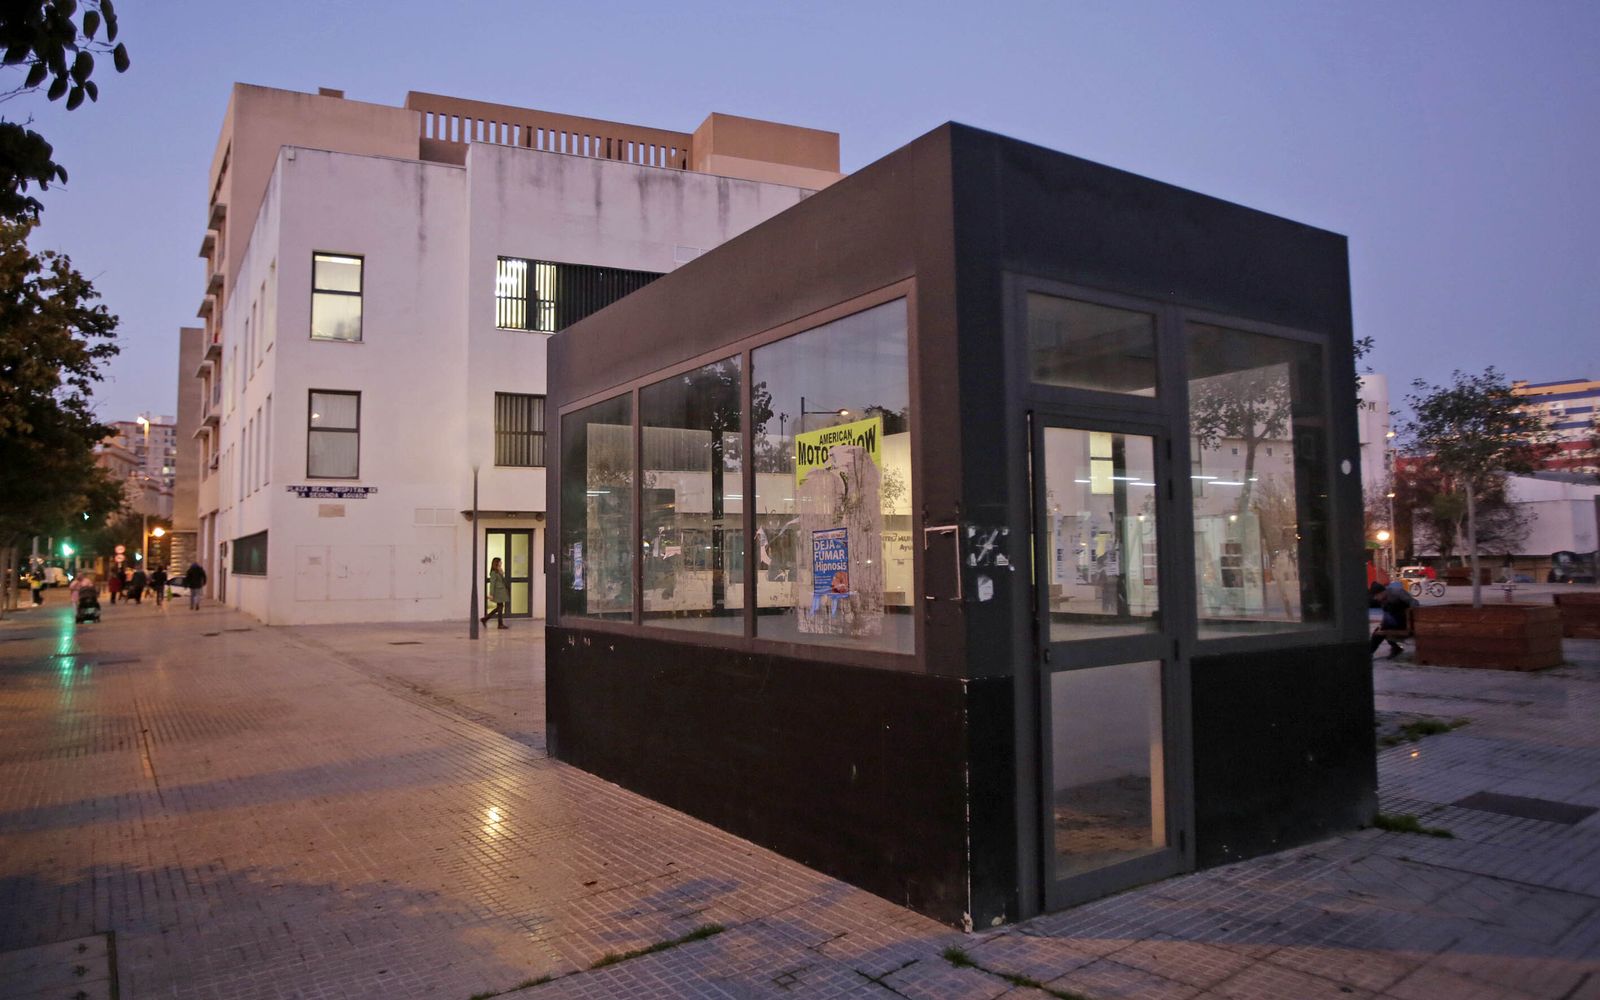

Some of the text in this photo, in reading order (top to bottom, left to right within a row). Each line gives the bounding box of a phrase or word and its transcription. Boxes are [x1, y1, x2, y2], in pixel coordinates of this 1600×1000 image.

[819, 429, 853, 445] AMERICAN
[814, 539, 835, 551] DEJA
[814, 549, 845, 561] FUMAR
[816, 560, 847, 574] Hipnosis
